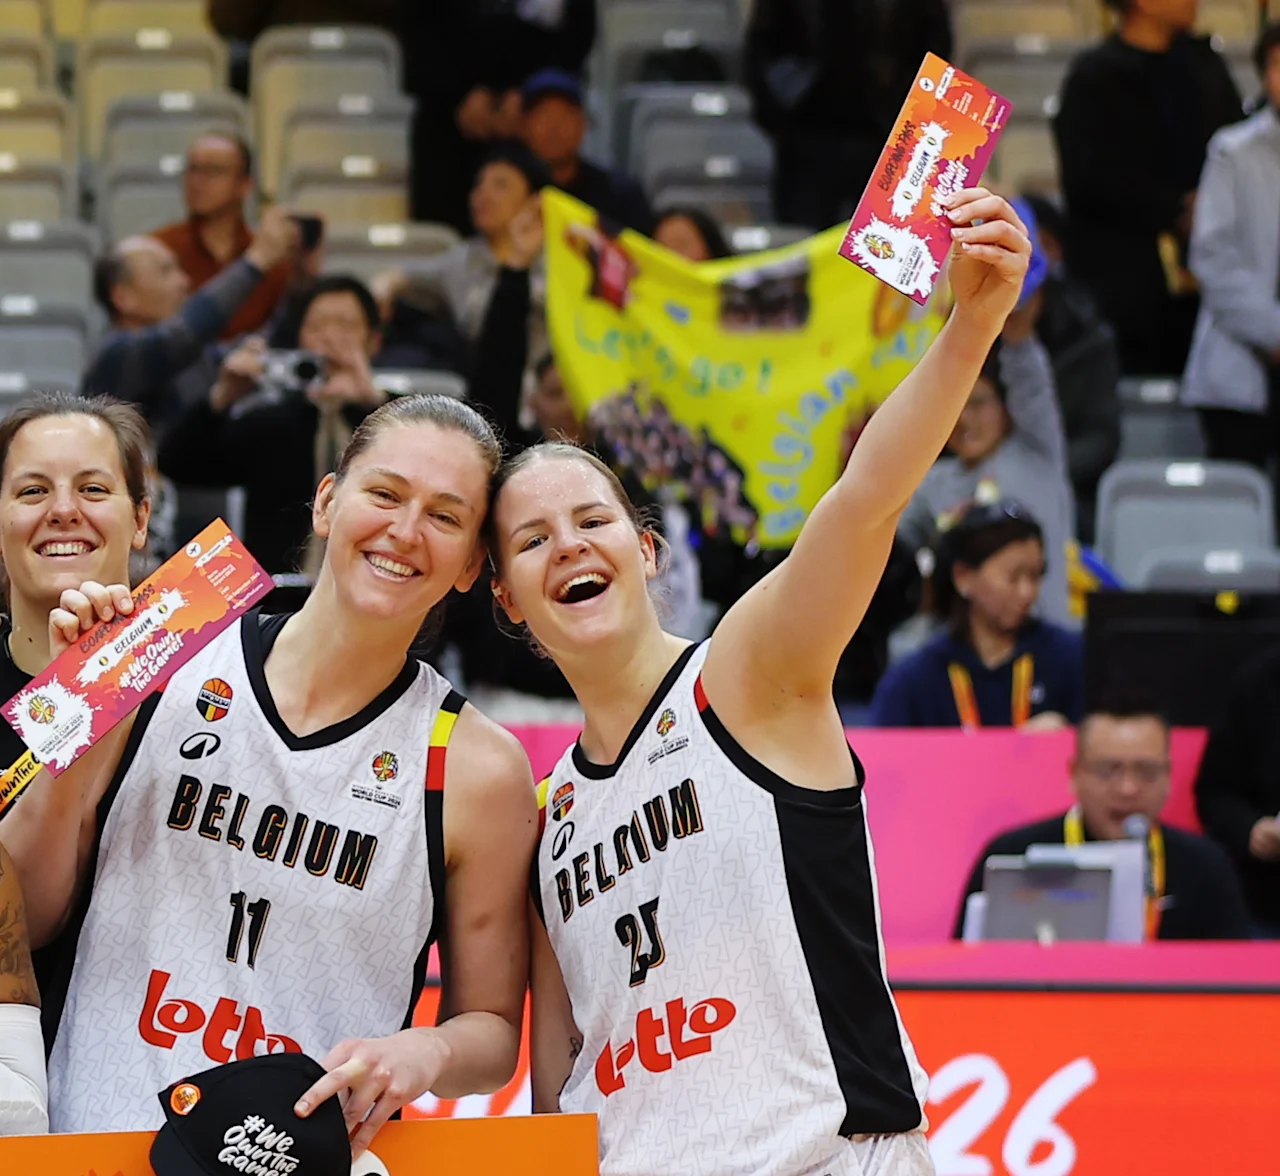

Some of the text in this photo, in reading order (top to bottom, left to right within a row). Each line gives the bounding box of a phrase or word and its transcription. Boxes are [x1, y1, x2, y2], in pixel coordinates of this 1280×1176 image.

[909, 150, 930, 188] BELGIUM
[113, 616, 154, 654] BELGIUM
[165, 773, 380, 892] BELGIUM
[225, 890, 273, 972] 11
[242, 1113, 296, 1155] #We
